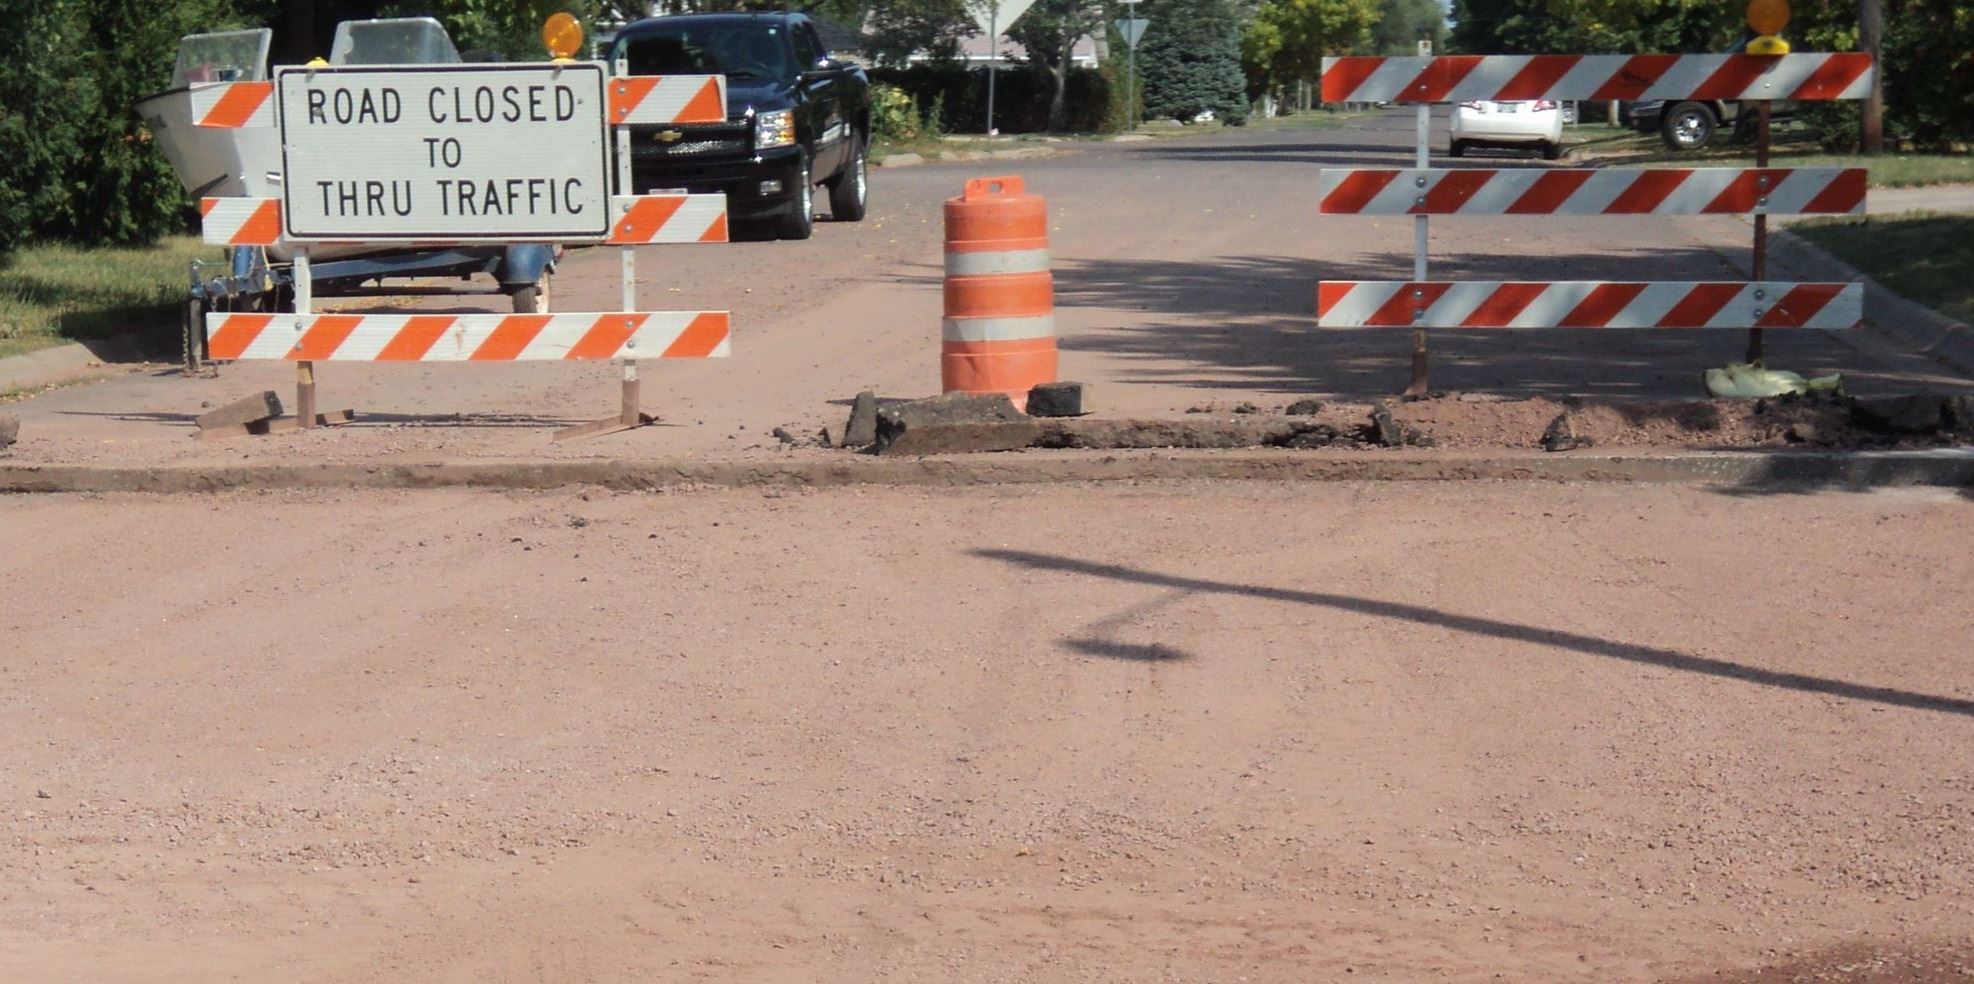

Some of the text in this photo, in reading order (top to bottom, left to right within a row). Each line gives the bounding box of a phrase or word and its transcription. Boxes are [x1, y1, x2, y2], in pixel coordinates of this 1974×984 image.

[308, 86, 575, 124] ROAD CLOSED
[424, 138, 462, 168] TO
[317, 178, 583, 216] THRU TRAFFIC
